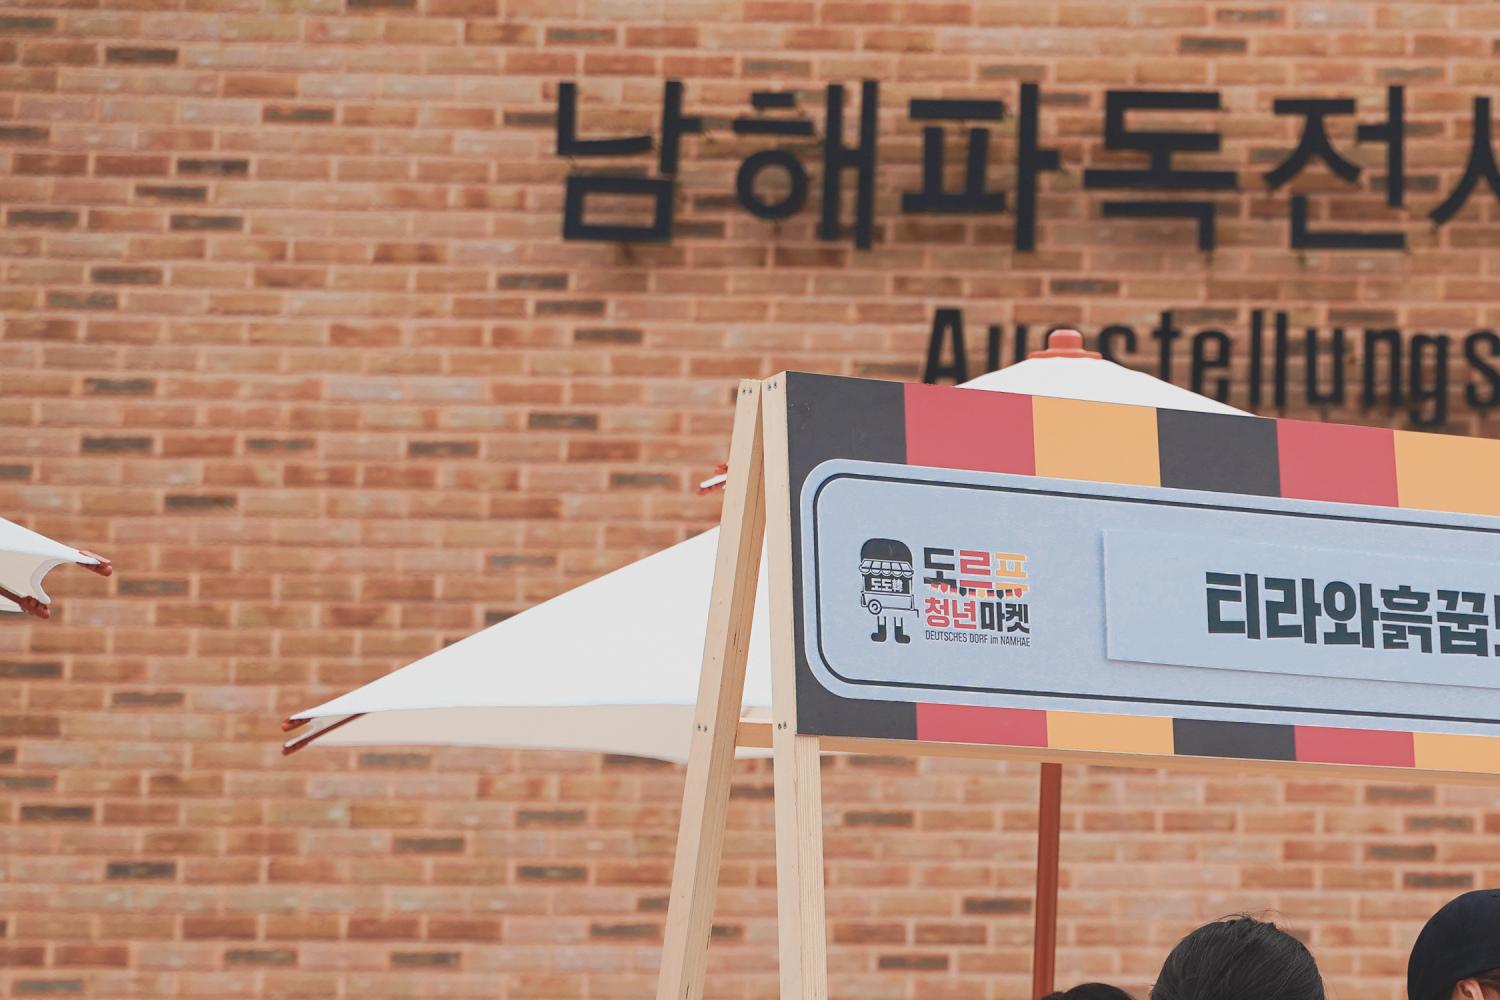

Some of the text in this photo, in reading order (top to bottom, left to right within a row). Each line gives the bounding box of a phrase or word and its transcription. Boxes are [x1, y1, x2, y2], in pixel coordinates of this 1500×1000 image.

[923, 546, 1029, 592] 도르프
[924, 596, 1031, 634] 청년마켓
[925, 629, 968, 643] DEUTSCHES
[969, 632, 989, 645] DORF
[1000, 635, 1031, 648] NAMHAE
